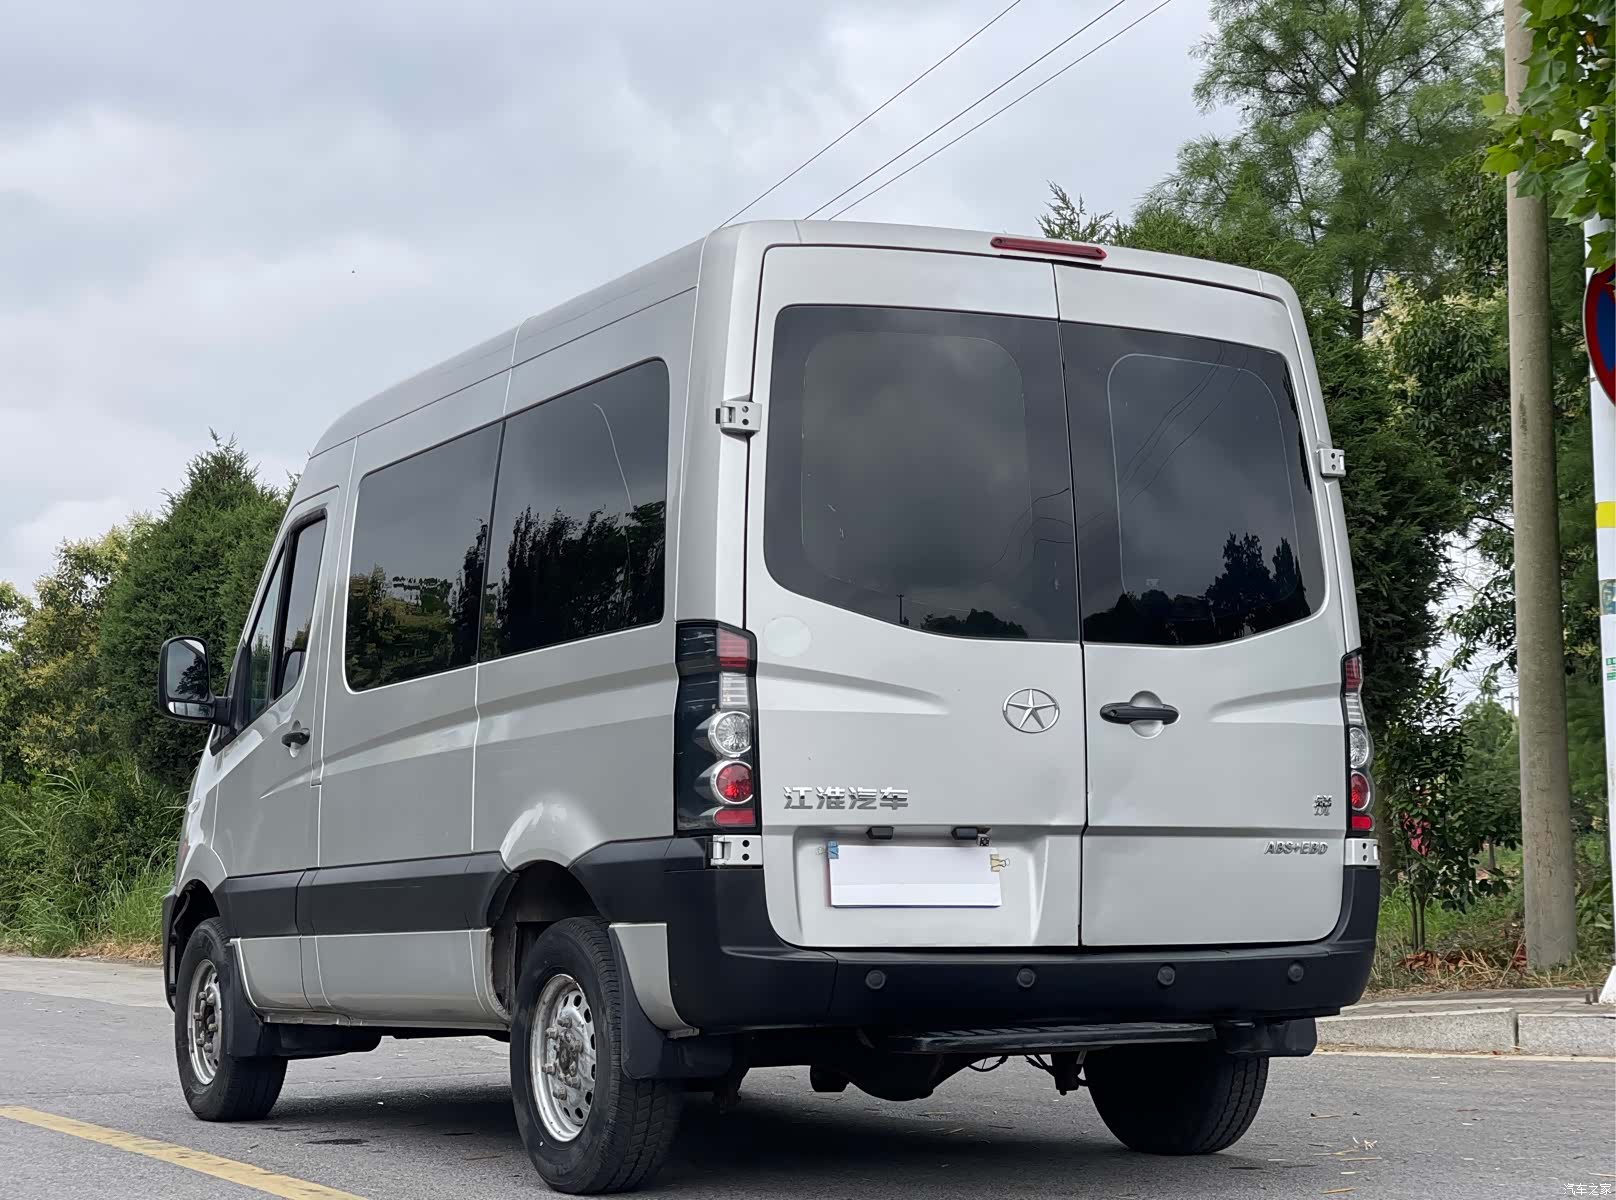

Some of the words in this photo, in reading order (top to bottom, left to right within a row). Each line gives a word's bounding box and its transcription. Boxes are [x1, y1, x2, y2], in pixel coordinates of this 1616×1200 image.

[783, 786, 909, 810] 江淮汽车
[1264, 841, 1328, 855] ABS+EBD
